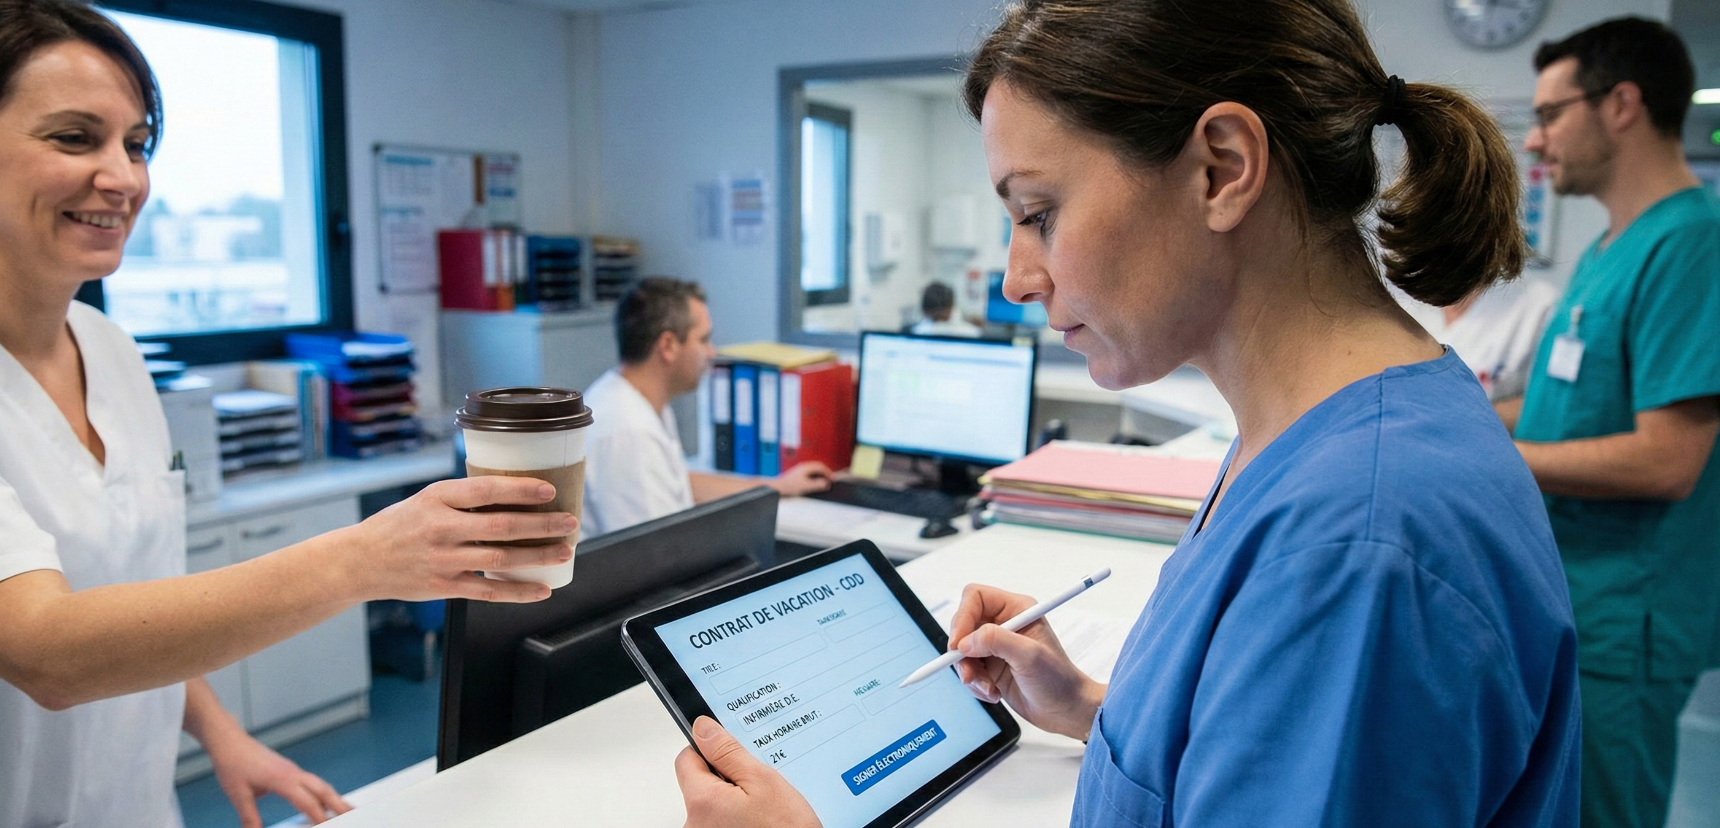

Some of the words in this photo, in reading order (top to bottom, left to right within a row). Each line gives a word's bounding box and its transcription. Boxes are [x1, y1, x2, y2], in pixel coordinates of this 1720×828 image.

[689, 614, 753, 649] CONTRAT
[752, 607, 775, 625] DE
[772, 584, 835, 616] VACATION
[839, 573, 865, 591] CDD
[753, 733, 773, 749] TAUX
[770, 749, 787, 764] 21€
[852, 763, 878, 786] SIGNER
